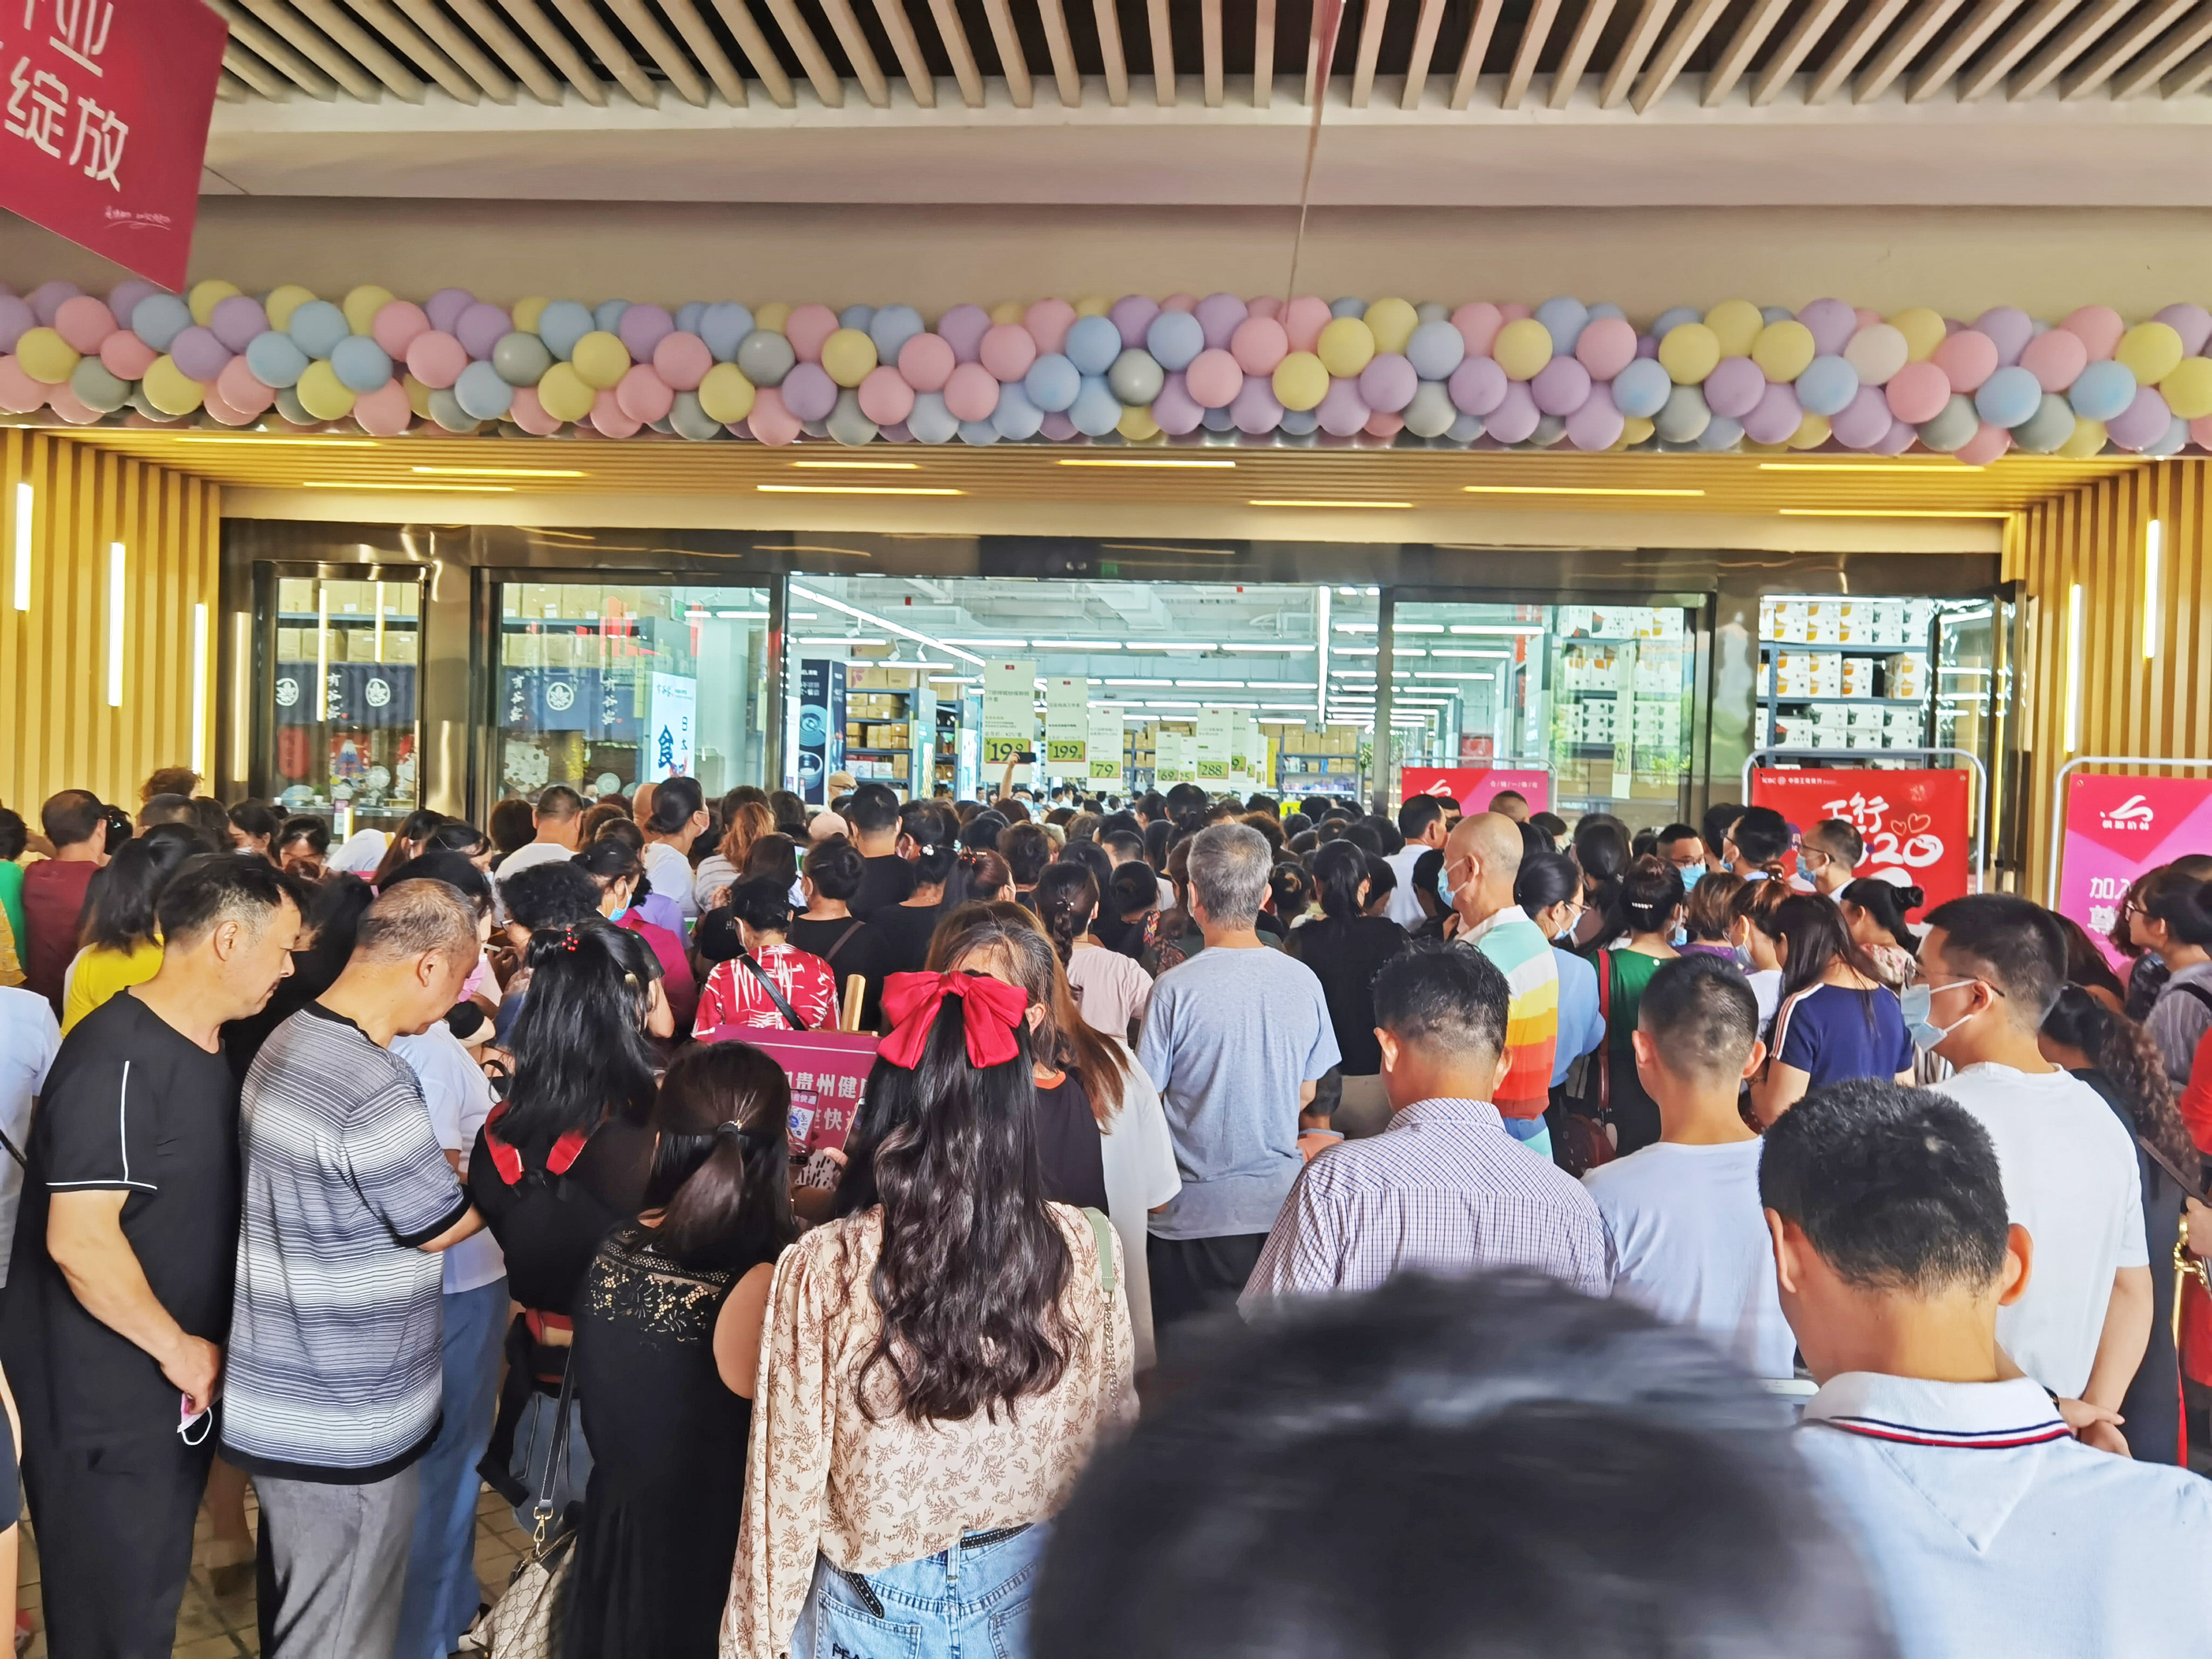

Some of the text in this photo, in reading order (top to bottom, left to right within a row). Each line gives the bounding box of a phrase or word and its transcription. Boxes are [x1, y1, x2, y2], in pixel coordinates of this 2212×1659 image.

[4, 56, 129, 192] 绽放
[1854, 832, 1944, 868] 20
[785, 1071, 868, 1100] 贵州健
